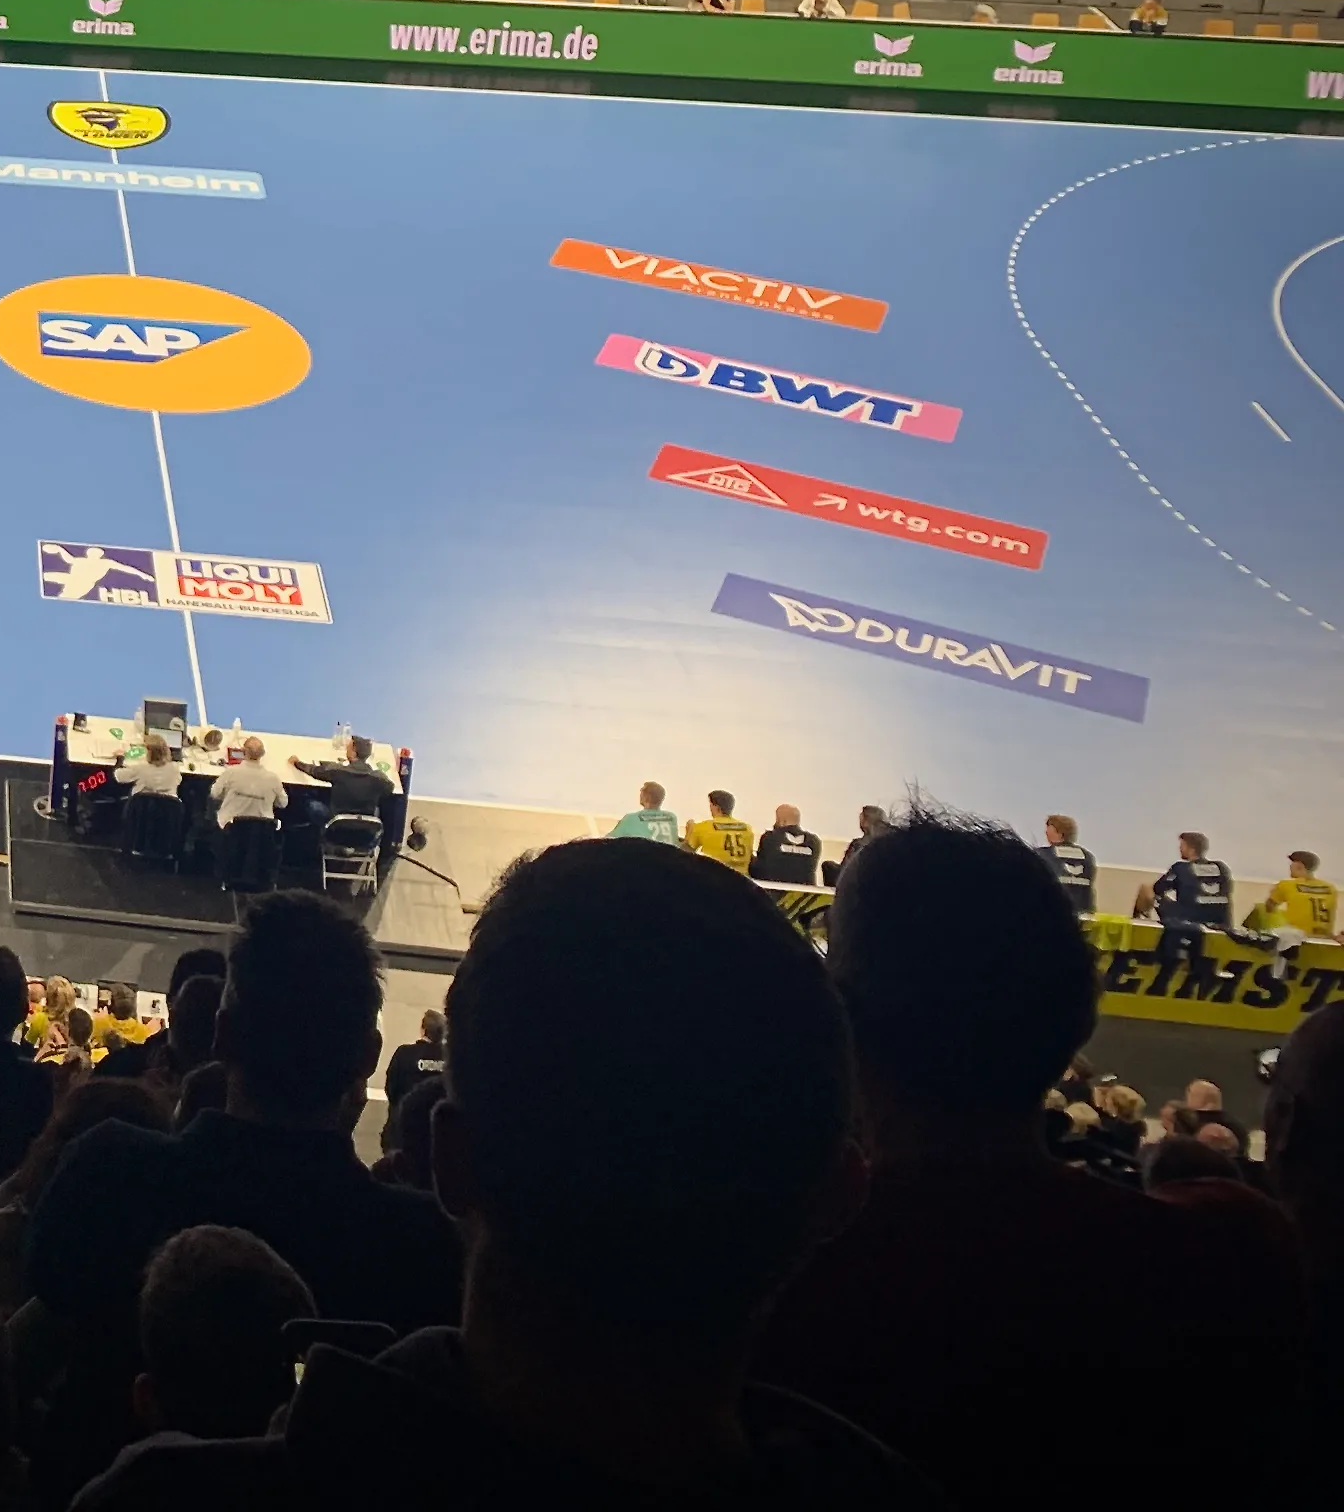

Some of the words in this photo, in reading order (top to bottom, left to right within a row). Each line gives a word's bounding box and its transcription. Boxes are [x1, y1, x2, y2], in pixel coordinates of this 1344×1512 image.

[72, 18, 136, 36] erima
[389, 21, 599, 61] www.erima.de
[854, 59, 923, 77] erima
[994, 65, 1064, 85] erima
[605, 248, 843, 309] VIACTIV
[41, 319, 201, 357] SAP
[707, 361, 914, 426] BWT
[856, 502, 1031, 556] wtg.com
[180, 559, 295, 586] LIQUI
[98, 587, 160, 607] HBL
[183, 578, 302, 606] MOLY
[854, 619, 1092, 695] DURAVIT
[723, 833, 746, 857] 45
[1307, 897, 1331, 923] 15
